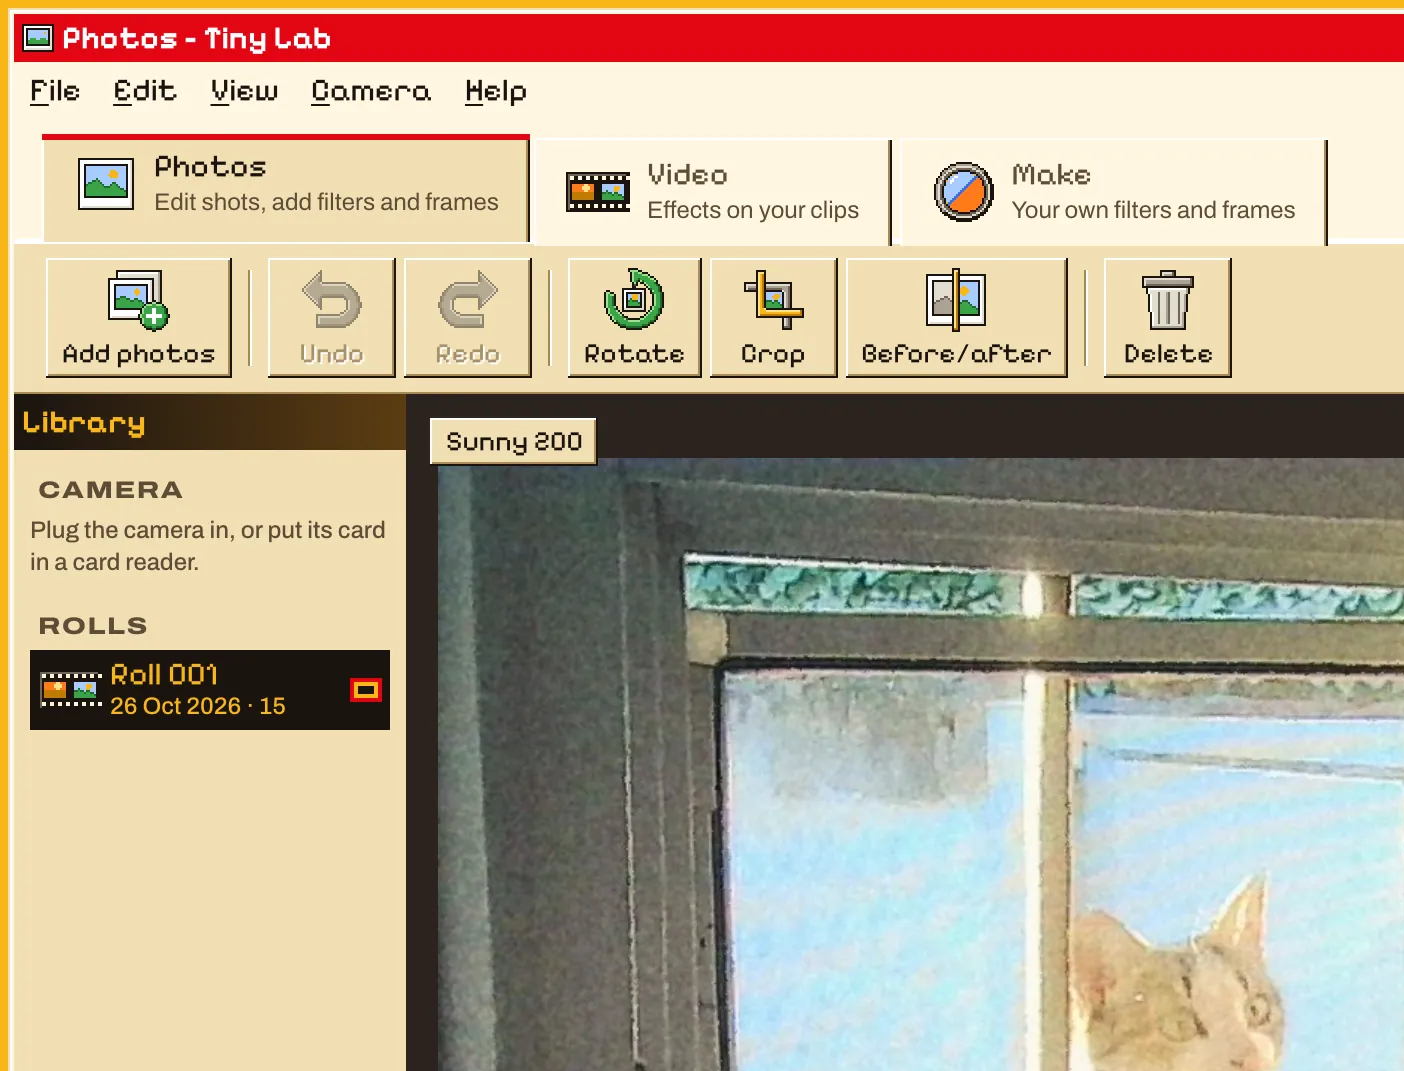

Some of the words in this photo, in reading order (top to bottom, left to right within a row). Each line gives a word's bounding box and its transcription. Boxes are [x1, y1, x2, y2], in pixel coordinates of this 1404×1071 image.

[63, 26, 178, 50] Photos
[204, 26, 267, 55] Tiny
[274, 26, 331, 50] Lab
[31, 79, 80, 102] File
[114, 79, 178, 102] Edit
[211, 79, 278, 102] View
[312, 79, 432, 102] Camera
[464, 79, 527, 107] Help
[155, 155, 266, 178] Photos
[648, 163, 728, 186] Video
[1012, 163, 1091, 186] Make
[155, 192, 197, 211] Edit
[201, 192, 266, 214] shots,
[272, 192, 312, 211] add
[316, 191, 375, 211] filters
[380, 192, 420, 211] and
[424, 191, 499, 211] frames
[648, 199, 722, 219] Effects
[726, 204, 753, 219] on
[758, 204, 807, 223] your
[810, 200, 860, 223] clips
[1011, 200, 1061, 219] Your
[1064, 204, 1109, 219] own
[1113, 199, 1172, 219] filters
[1177, 199, 1217, 219] and
[1221, 199, 1296, 219] frames
[63, 343, 110, 363] Add
[117, 343, 215, 368] photos
[300, 343, 366, 366] Undo
[436, 343, 502, 366] Redo
[585, 343, 685, 364] Rotate
[741, 343, 805, 368] Crop
[862, 343, 1052, 363] Before/after
[1125, 343, 1213, 364] Delete
[23, 411, 145, 439] Library
[447, 431, 528, 457] Sunny
[534, 431, 582, 451] 200
[38, 480, 183, 499] CAMERA
[31, 519, 80, 544] Plug
[83, 520, 119, 539] the
[123, 524, 205, 539] camera
[210, 520, 235, 543] in,
[241, 524, 264, 539] or
[268, 521, 303, 543] put
[308, 520, 333, 539] its
[338, 519, 385, 539] card
[39, 616, 147, 635] ROLLS
[111, 663, 161, 686] Roll
[169, 663, 217, 686] 001
[110, 696, 138, 715] 26
[143, 696, 182, 715] Oct
[186, 696, 241, 715] 2026
[260, 696, 286, 715] 15
